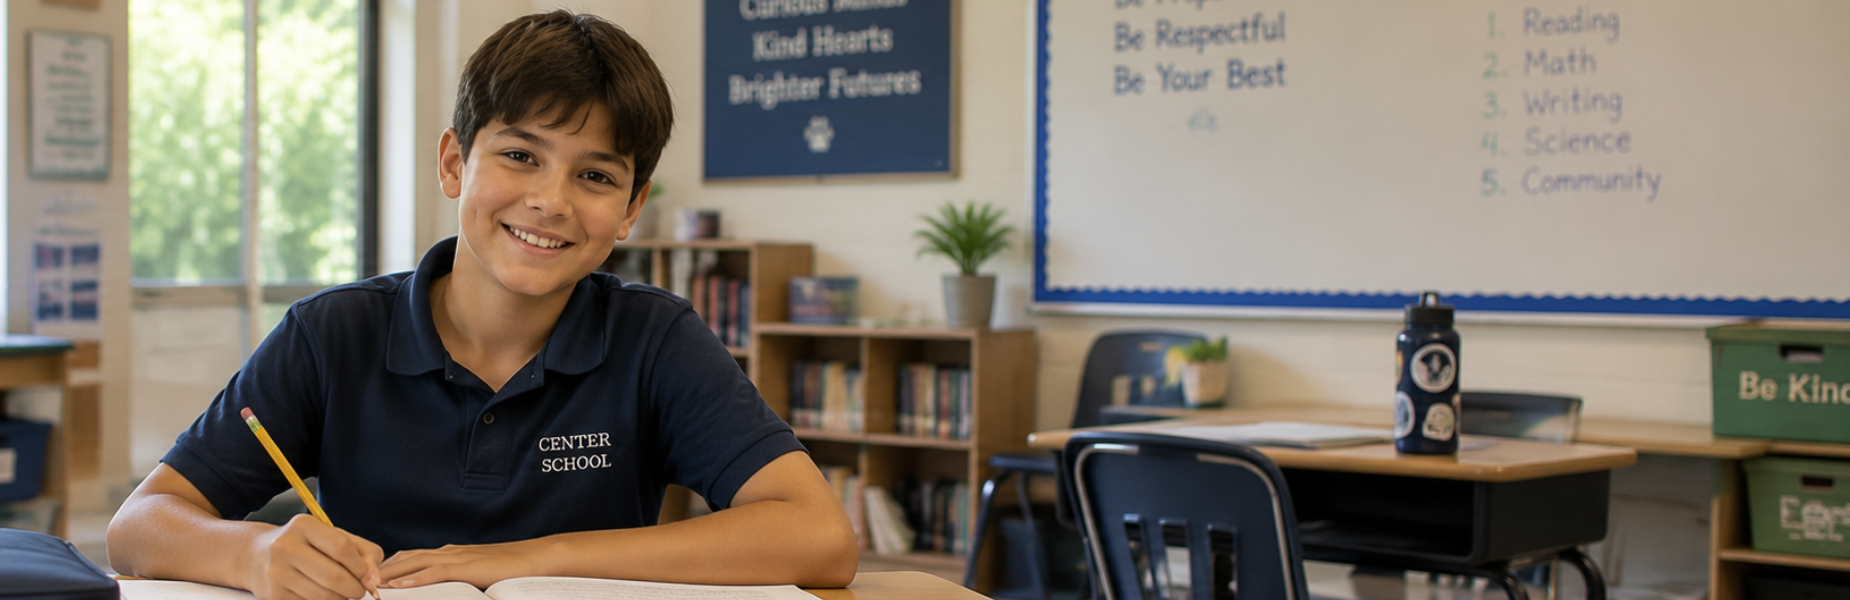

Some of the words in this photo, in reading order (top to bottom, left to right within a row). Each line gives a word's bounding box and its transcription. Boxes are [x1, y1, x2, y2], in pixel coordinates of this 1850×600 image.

[752, 26, 808, 62] Kind
[812, 23, 894, 57] Hearts
[1114, 21, 1145, 52] Be
[1155, 10, 1286, 55] Respectful
[1522, 5, 1621, 45] Reading
[1113, 65, 1146, 95] Be
[1154, 62, 1213, 93] Your
[1226, 58, 1288, 90] Best
[1482, 51, 1508, 80] 2.
[1523, 46, 1597, 77] Math
[729, 70, 825, 110] Brighter
[828, 67, 922, 99] Futures
[1482, 90, 1507, 119] 3.
[1521, 87, 1623, 124] Writing
[1524, 126, 1632, 157] Science
[1481, 168, 1507, 197] 5.
[1521, 163, 1662, 203] Community
[1739, 370, 1778, 400] Be
[539, 432, 611, 452] CENTER
[541, 454, 612, 472] SCHOOL
